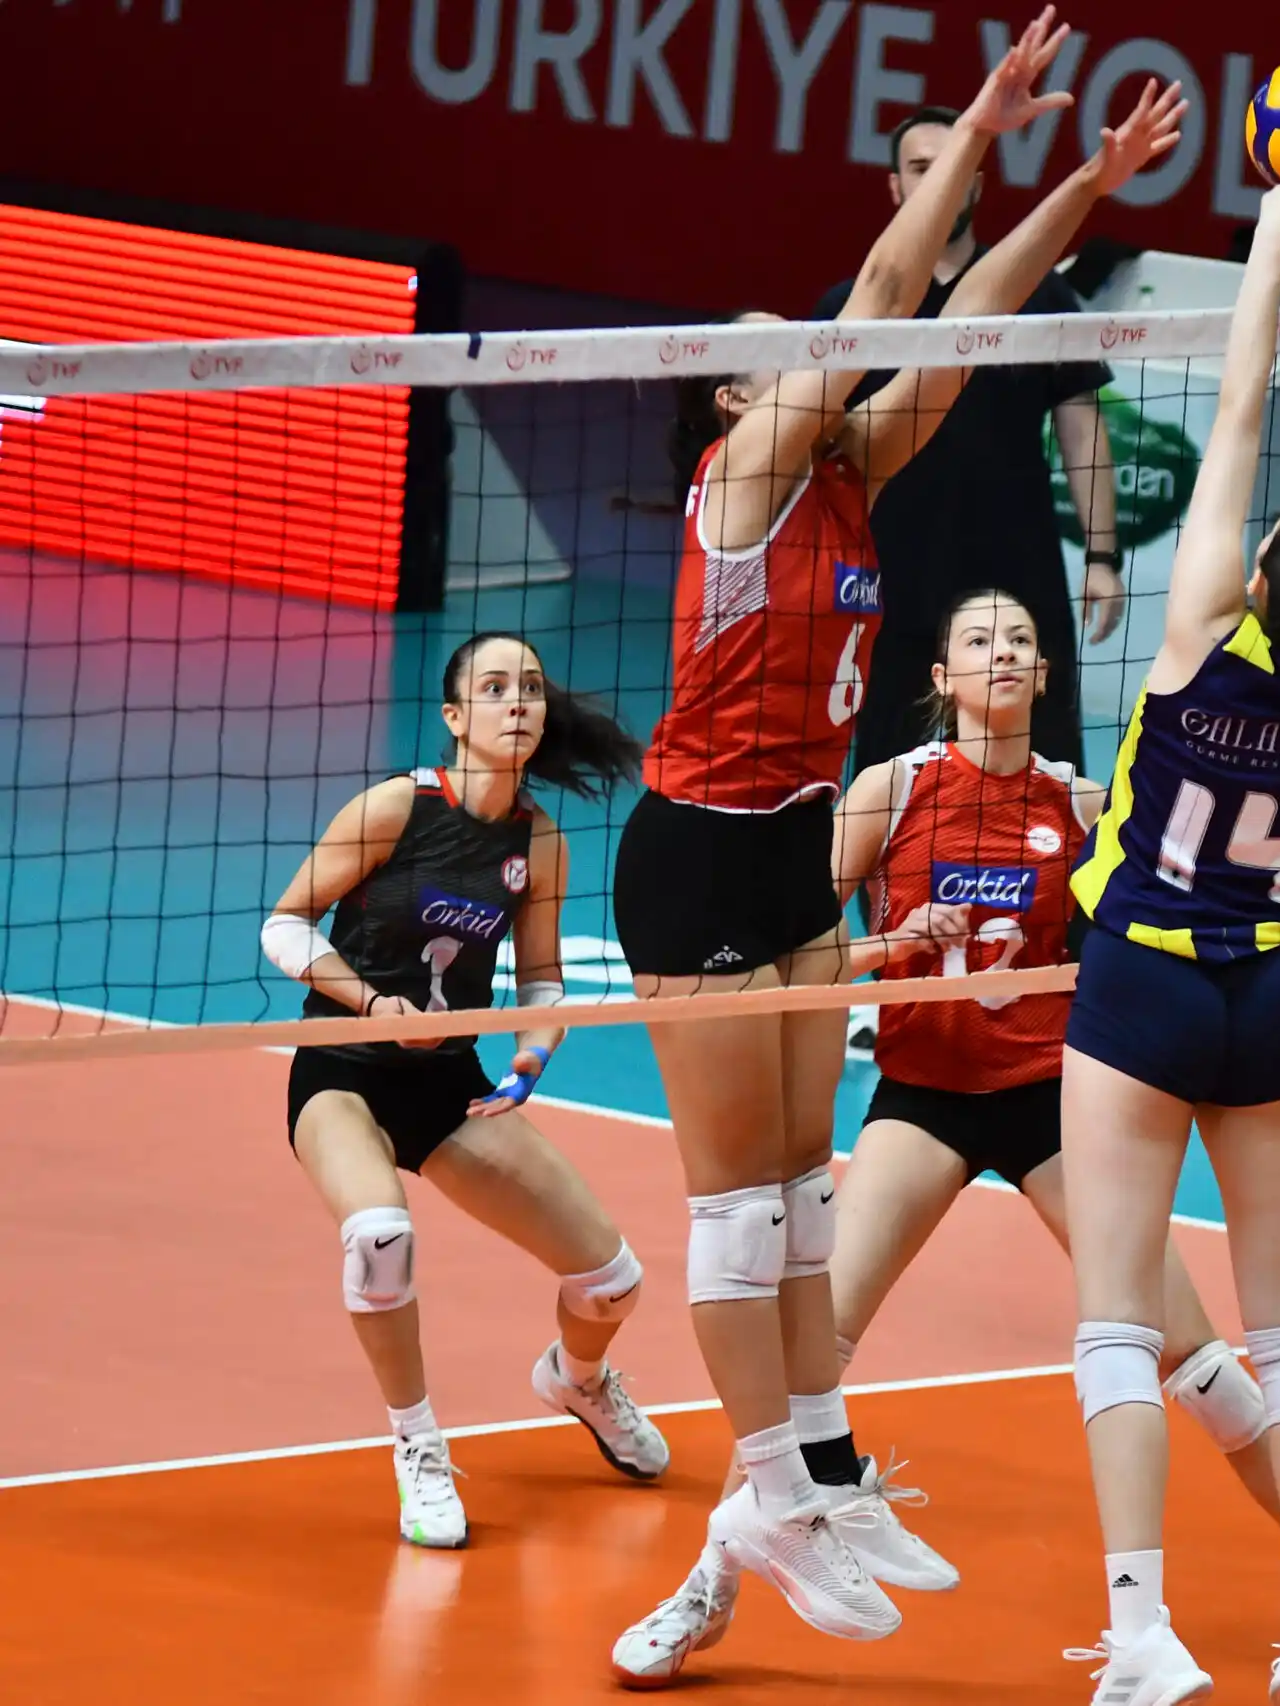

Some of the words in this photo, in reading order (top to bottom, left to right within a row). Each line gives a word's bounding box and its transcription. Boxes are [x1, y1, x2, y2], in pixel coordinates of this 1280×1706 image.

[977, 332, 1004, 349] TVF
[1120, 327, 1148, 344] TVF
[682, 341, 710, 358] TVF
[831, 337, 860, 354] TVF
[528, 348, 558, 365] TVF
[828, 623, 866, 727] 6
[938, 870, 1031, 905] Orkid
[421, 899, 505, 939] Orkid
